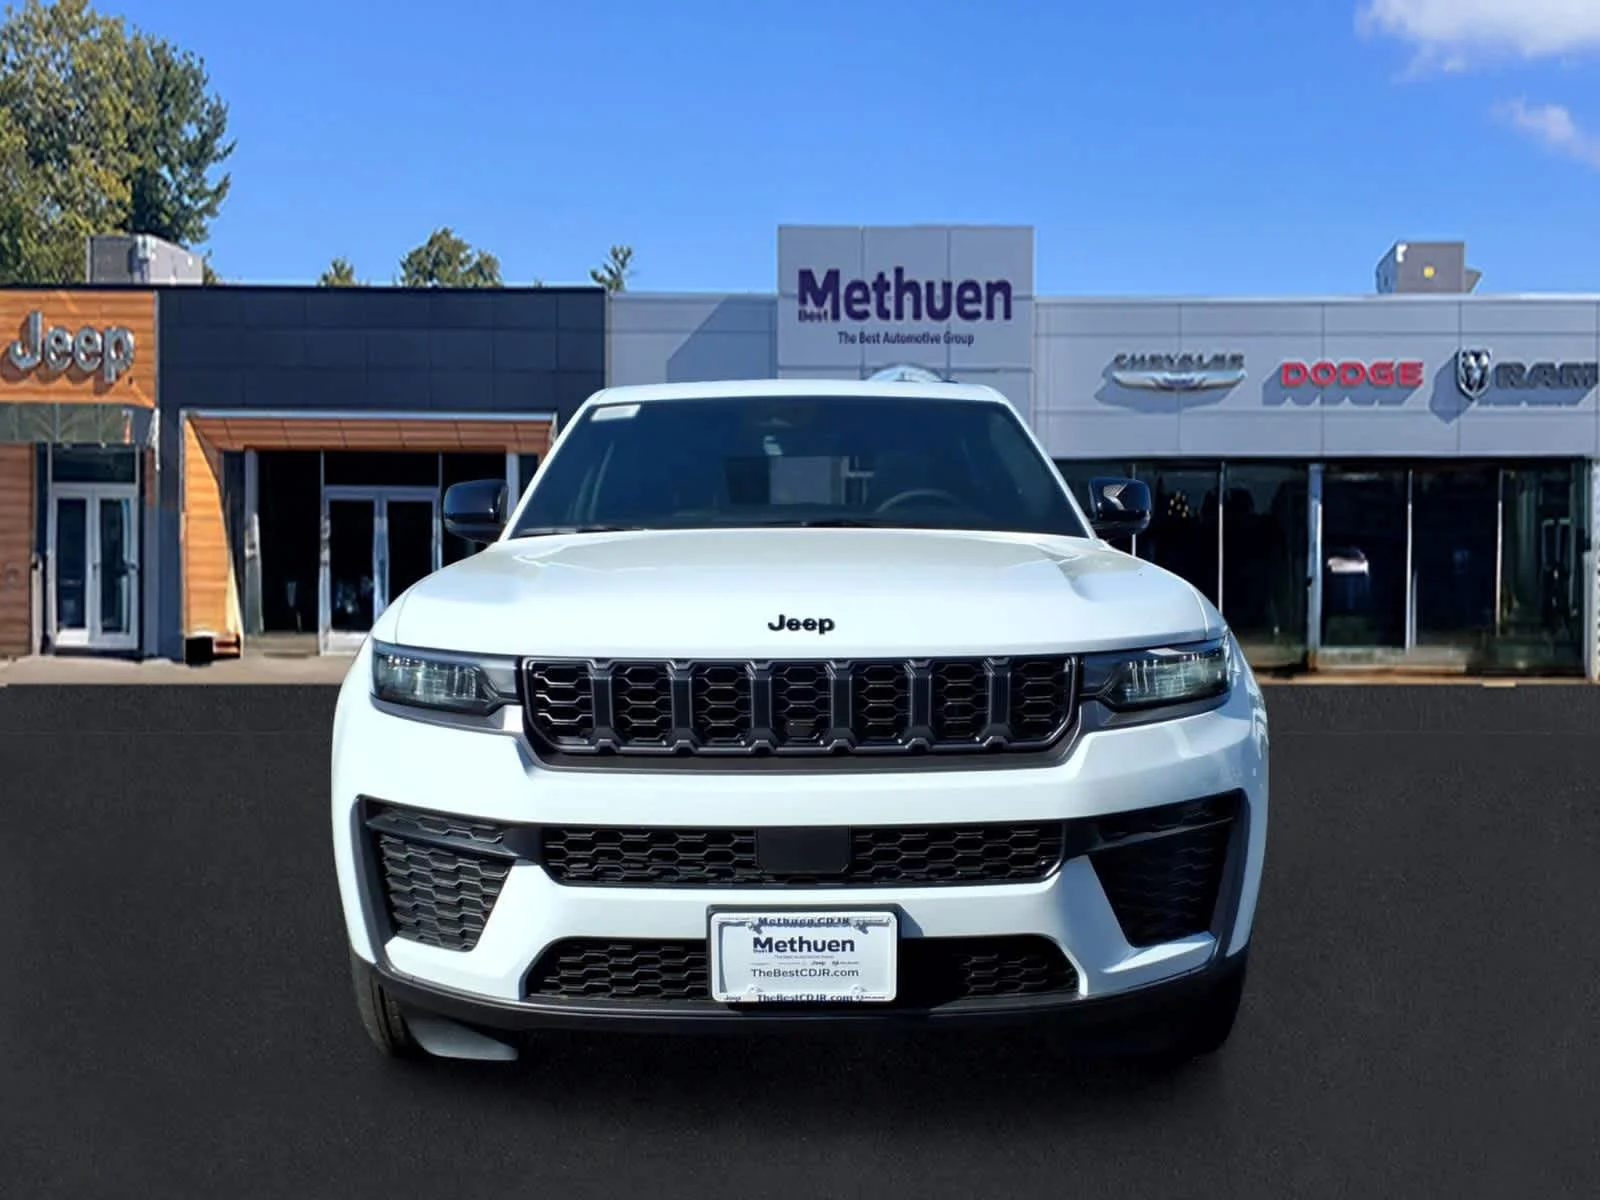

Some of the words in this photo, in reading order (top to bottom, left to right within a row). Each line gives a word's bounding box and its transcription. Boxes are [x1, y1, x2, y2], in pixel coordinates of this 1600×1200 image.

[798, 267, 1012, 321] Methuen
[9, 310, 135, 384] Jeep
[838, 331, 857, 344] The
[859, 331, 880, 344] Best
[883, 331, 941, 344] Automotive
[943, 331, 974, 347] Group
[1281, 361, 1424, 387] DODGE
[1496, 362, 1599, 389] RAM
[767, 613, 835, 635] Jeep
[753, 936, 855, 953] Methuen
[751, 968, 859, 978] TheBestCDJR.com
